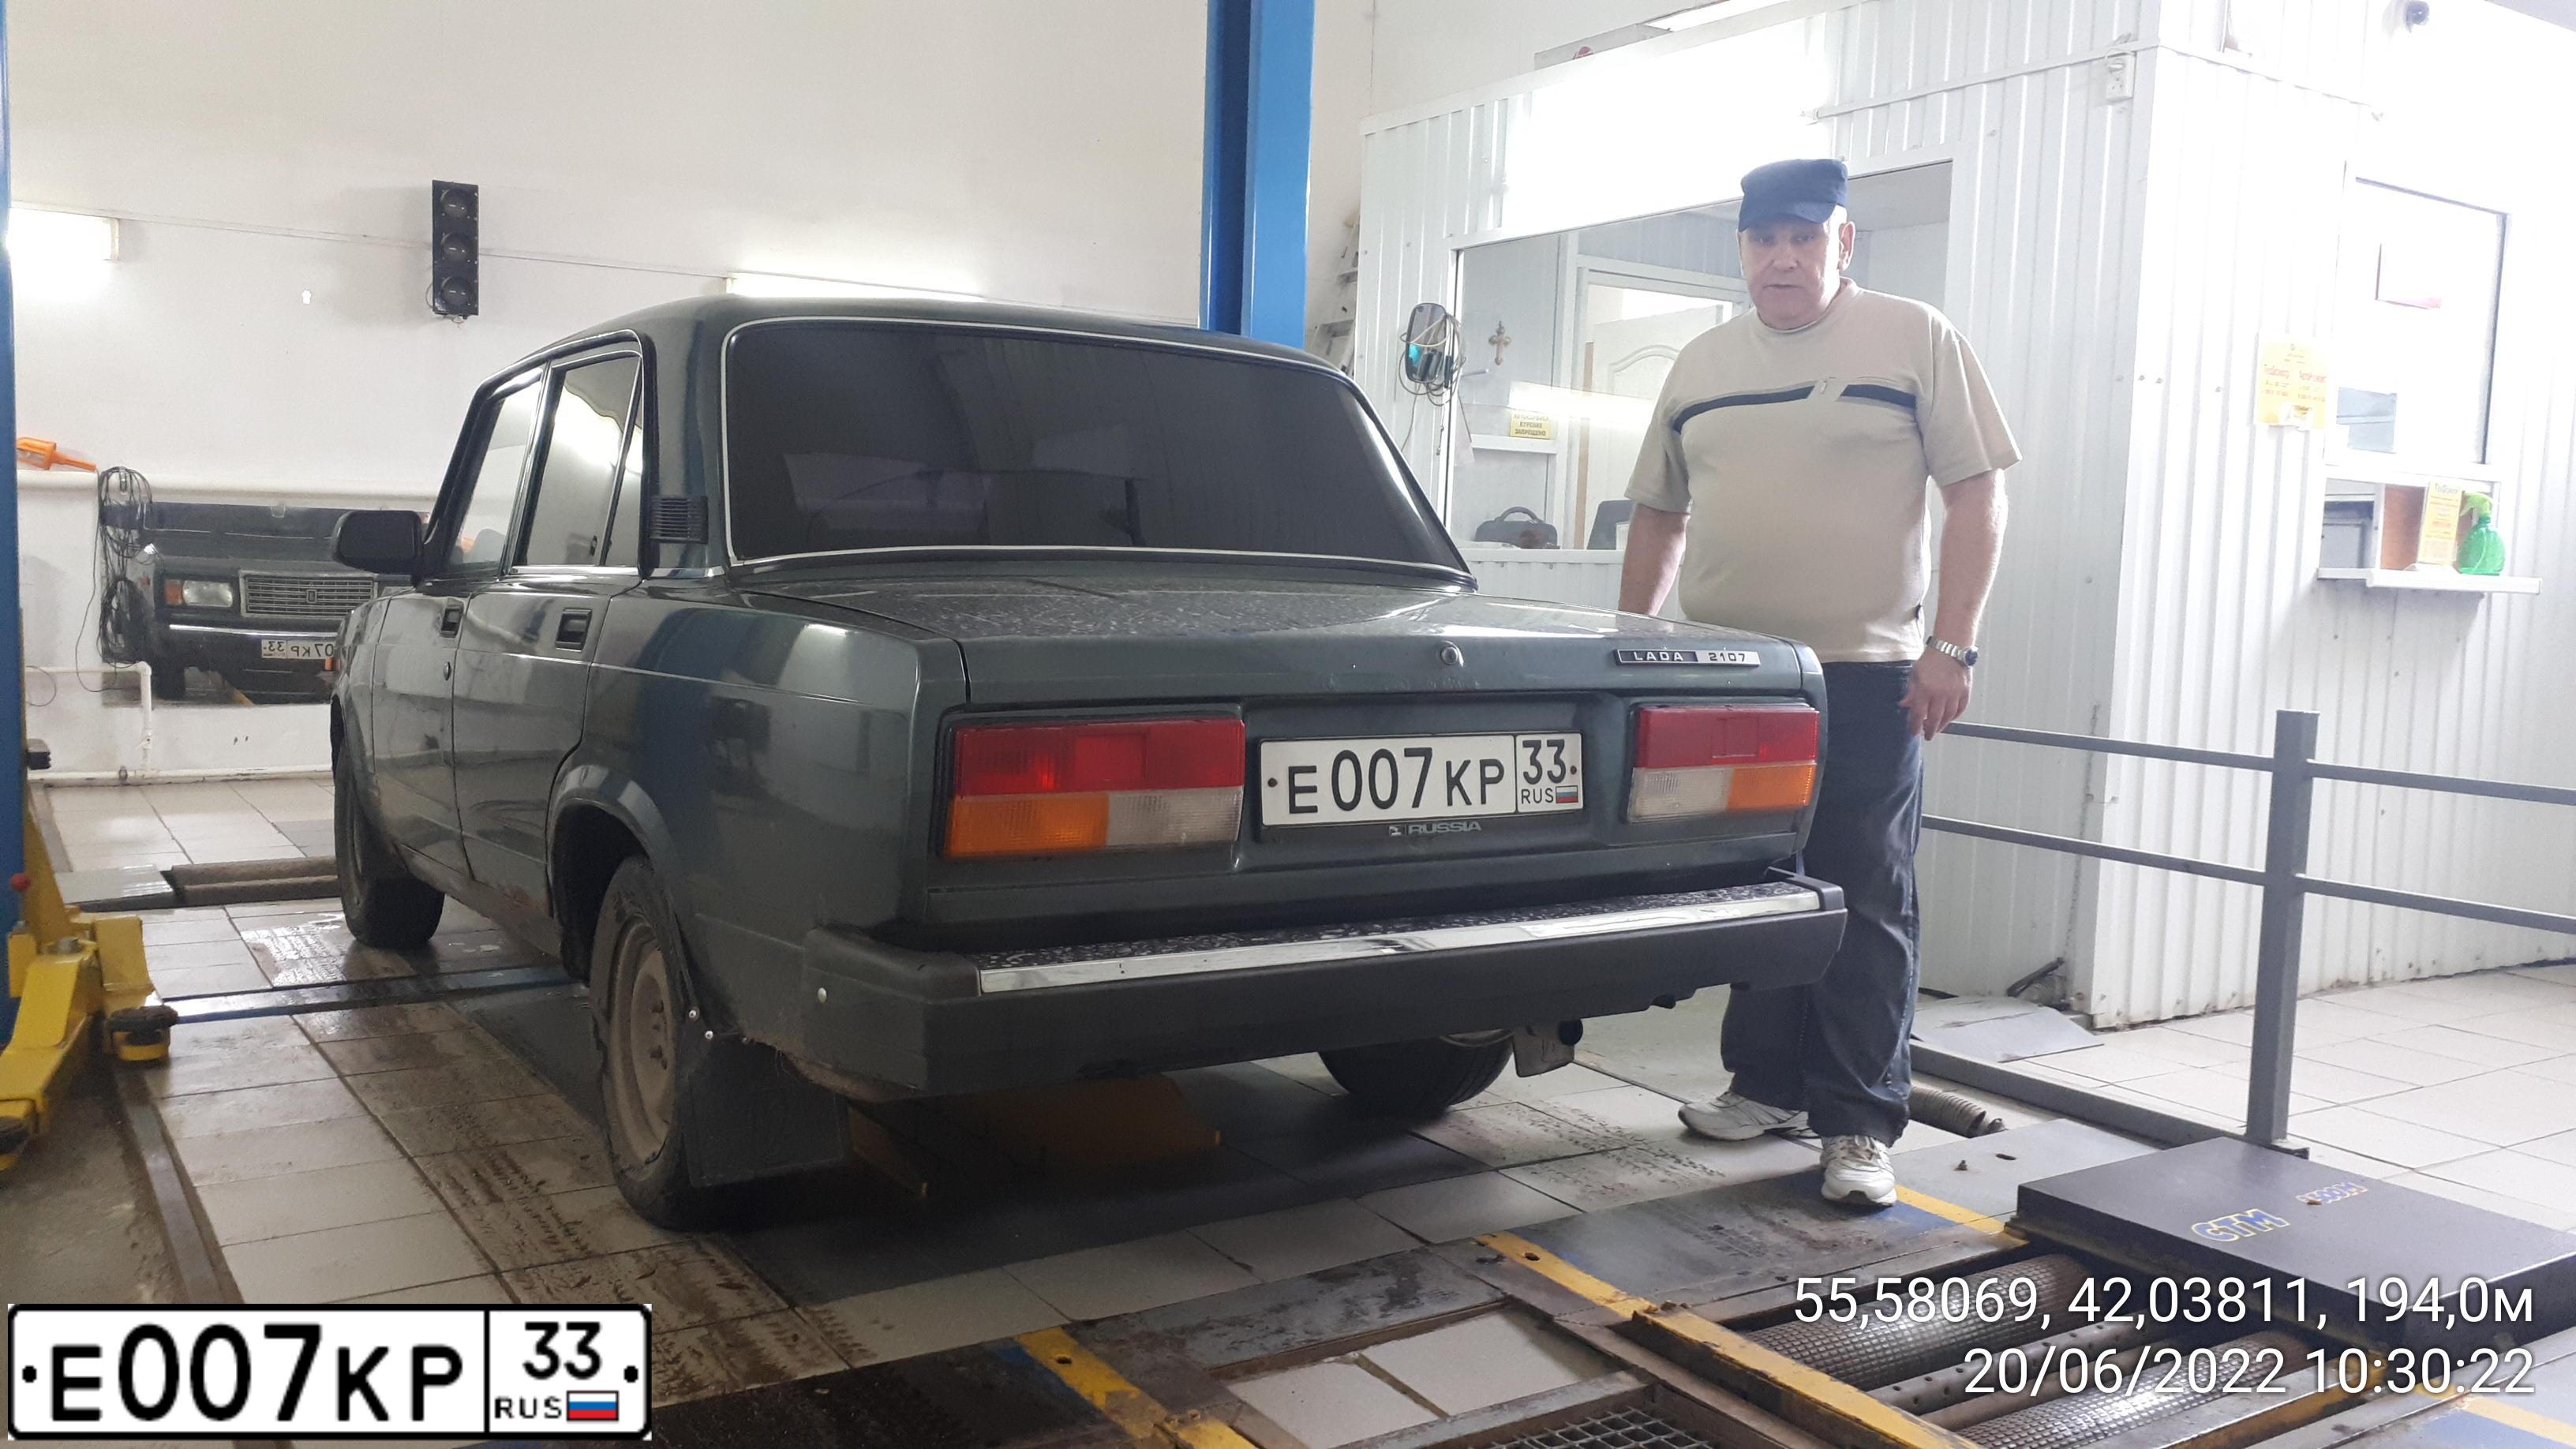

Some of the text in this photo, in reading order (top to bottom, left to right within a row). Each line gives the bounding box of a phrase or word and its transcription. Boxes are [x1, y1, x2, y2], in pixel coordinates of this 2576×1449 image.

[1634, 651, 1746, 662] LADA 2107
[1288, 739, 1566, 814] Е007КР 33
[1521, 788, 1554, 805] RUS
[1408, 821, 1482, 835] RUSSIA
